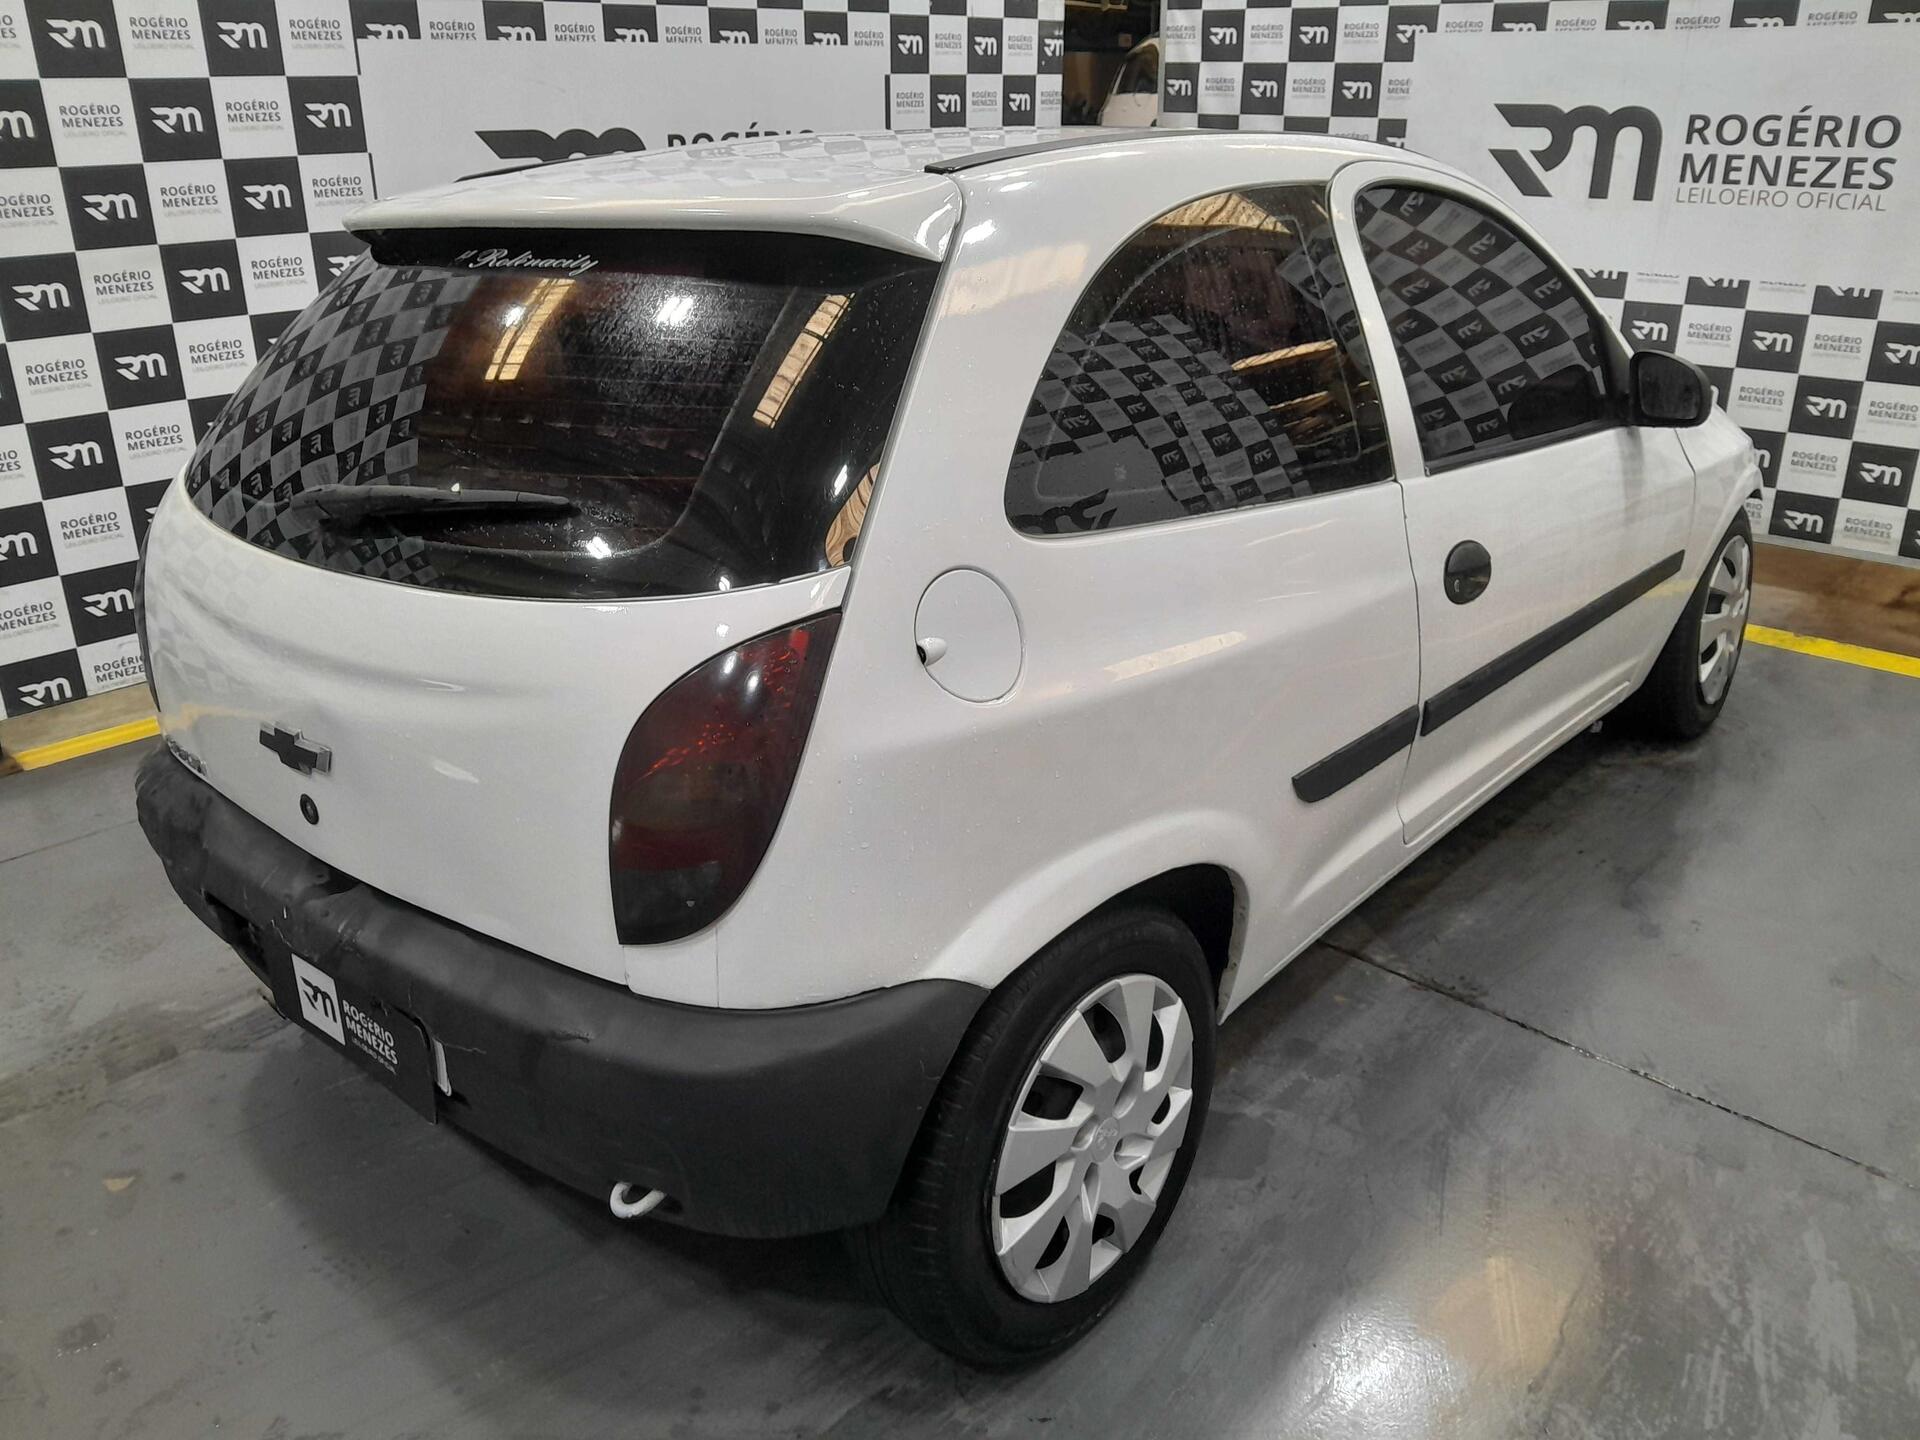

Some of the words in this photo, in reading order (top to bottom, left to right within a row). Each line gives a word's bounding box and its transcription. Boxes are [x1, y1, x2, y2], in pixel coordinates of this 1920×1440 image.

[129, 16, 188, 28] ROGÉRIO
[1675, 15, 1721, 26] ROGÉRIO
[1807, 10, 1858, 22] ROGÉRIO
[288, 19, 340, 30] ROGÉRIO
[429, 20, 475, 32] ROGÉRIO
[554, 23, 595, 34] ROGÉRIO
[1251, 23, 1284, 32] ROGÉRIO
[1344, 22, 1379, 31] ROGÉRIO
[1445, 19, 1484, 29] ROGÉRIO
[1555, 17, 1597, 28] ROGÉRIO
[131, 29, 191, 41] MENEZES
[291, 30, 342, 41] MENEZES
[665, 26, 702, 35] ROGÉRIO
[765, 28, 798, 38] ROGÉRIO
[854, 31, 884, 39] ROGÉRIO
[935, 32, 962, 41] ROGÉRIO
[1250, 31, 1284, 40] MENEZES
[1343, 30, 1379, 39] MENEZES
[1008, 35, 1033, 43] ROGÉRIO
[935, 41, 962, 50] MENEZES
[1008, 43, 1032, 51] MENEZES
[1205, 84, 1235, 92] MENEZES
[1293, 78, 1326, 86] ROGÉRIO
[896, 91, 924, 100] ROGÉRIO
[972, 91, 997, 99] ROGÉRIO
[1292, 86, 1325, 94] MENEZES
[225, 100, 279, 112] ROGÉRIO
[897, 99, 925, 108] MENEZES
[972, 98, 997, 107] MENEZES
[59, 104, 121, 117] ROGÉRIO
[227, 111, 281, 122] MENEZES
[61, 116, 124, 128] MENEZES
[1685, 106, 1901, 149] ROGÉRIO
[1679, 153, 1897, 191] MENEZES
[312, 176, 362, 188] ROGÉRIO
[160, 184, 216, 197] ROGÉRIO
[313, 186, 363, 199] MENEZES
[0, 193, 51, 206] OGÉRIO
[162, 195, 218, 208] MENEZES
[1676, 188, 1789, 207] LEILOEIRO
[1796, 190, 1886, 212] OFICIAL
[251, 257, 302, 269] ROGÉRIO
[93, 270, 151, 285] ROGÉRIO
[252, 267, 305, 279] MENEZES
[96, 282, 154, 296] MENEZES
[1689, 322, 1732, 334] ROGÉRIO
[1687, 330, 1732, 342] MENEZES
[1814, 333, 1862, 345] ROGÉRIO
[189, 339, 242, 354] ROGÉRIO
[1813, 342, 1861, 354] MENEZES
[190, 350, 245, 365] MENEZES
[25, 358, 85, 375] ROGÉRIO
[27, 370, 88, 387] MENEZES
[1739, 385, 1784, 398] ROGÉRIO
[1738, 394, 1783, 406] MENEZES
[1870, 400, 1919, 413] ROGÉRIO
[1868, 408, 1917, 422] MENEZES
[125, 424, 180, 440] ROGÉRIO
[127, 434, 183, 451] MENEZES
[1791, 451, 1838, 464] ROGÉRIO
[1790, 458, 1837, 472] MENEZES
[60, 511, 117, 529] ROGÉRIO
[1845, 517, 1893, 531] ROGÉRIO
[62, 522, 120, 540] MENEZES
[1843, 525, 1891, 539] MENEZES
[96, 664, 144, 683] MENEZE
[346, 1016, 398, 1064] MENEZES
